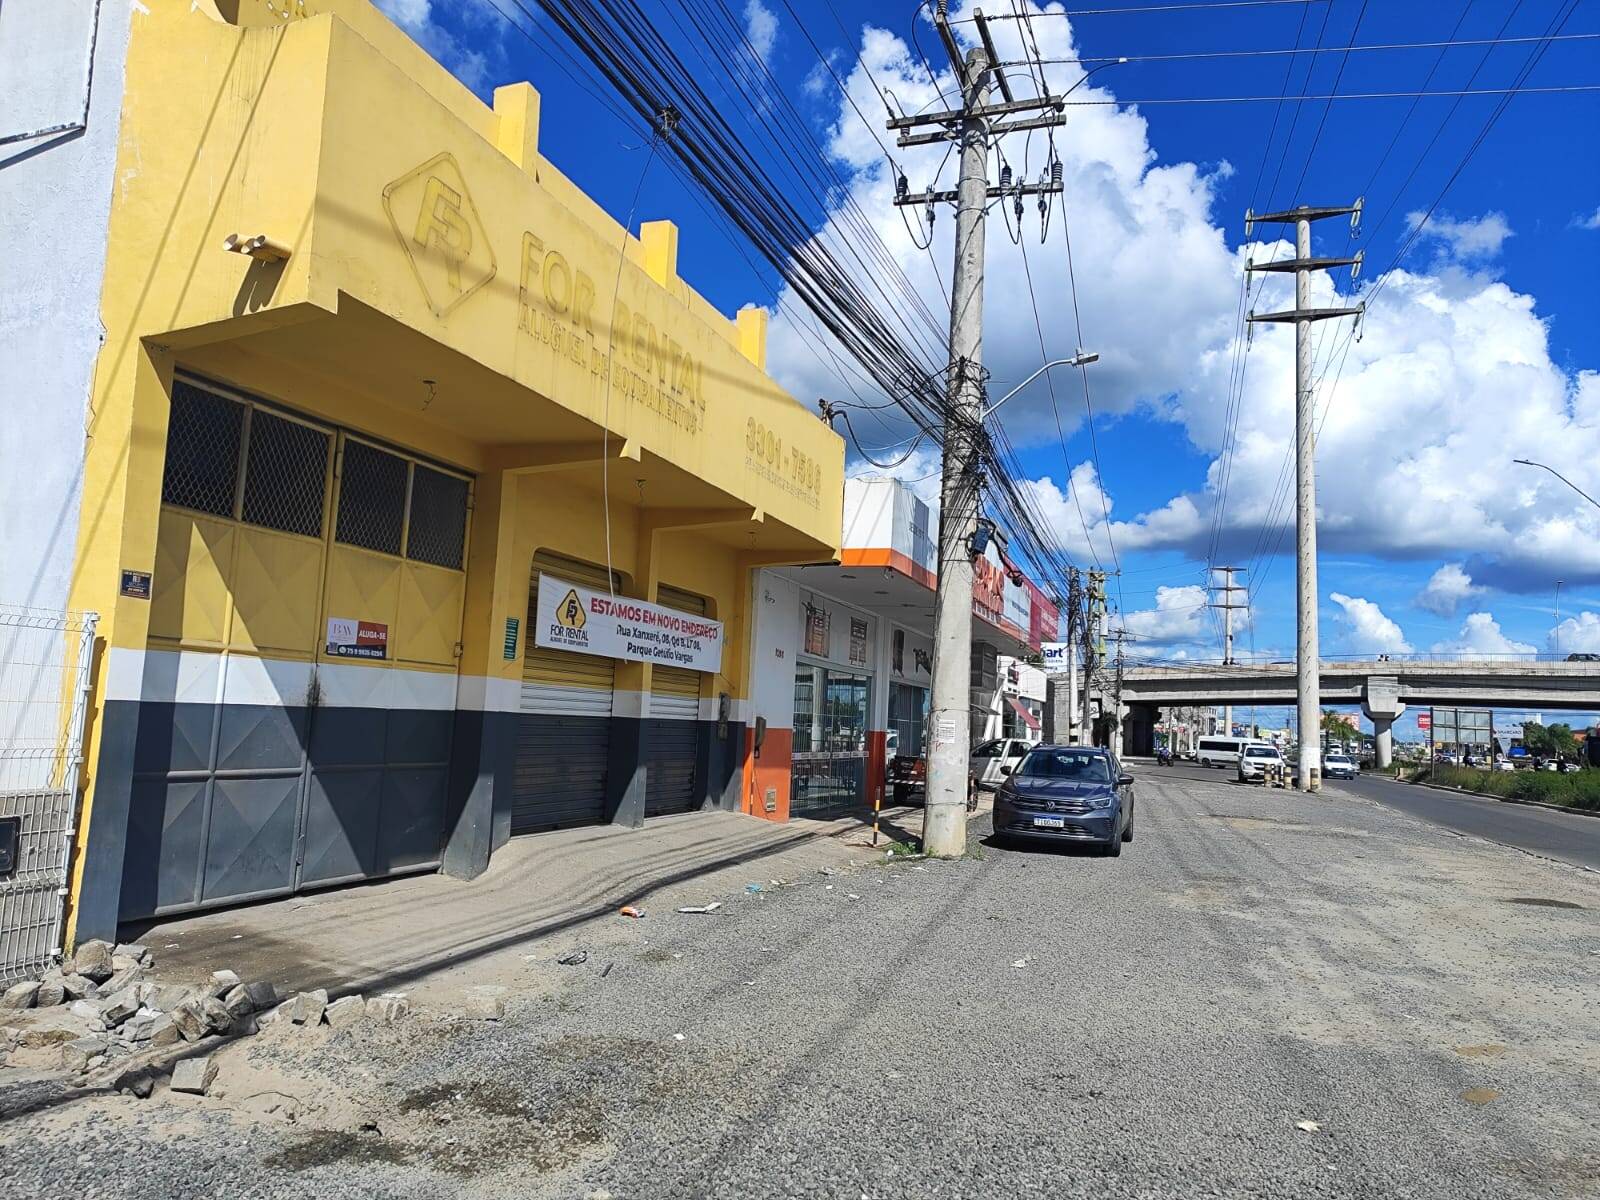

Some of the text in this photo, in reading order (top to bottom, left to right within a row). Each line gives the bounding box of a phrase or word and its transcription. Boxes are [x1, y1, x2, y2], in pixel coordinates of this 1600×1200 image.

[518, 230, 706, 413] FOR RENTAL
[590, 597, 718, 642] ESTAMOS EM NOVO ENDEREÇO
[358, 629, 387, 640] ALUGA-SE
[550, 624, 589, 641] FOR RENTAL
[616, 624, 631, 637] Rua
[627, 642, 653, 657] Parque
[674, 650, 694, 664] Vargas
